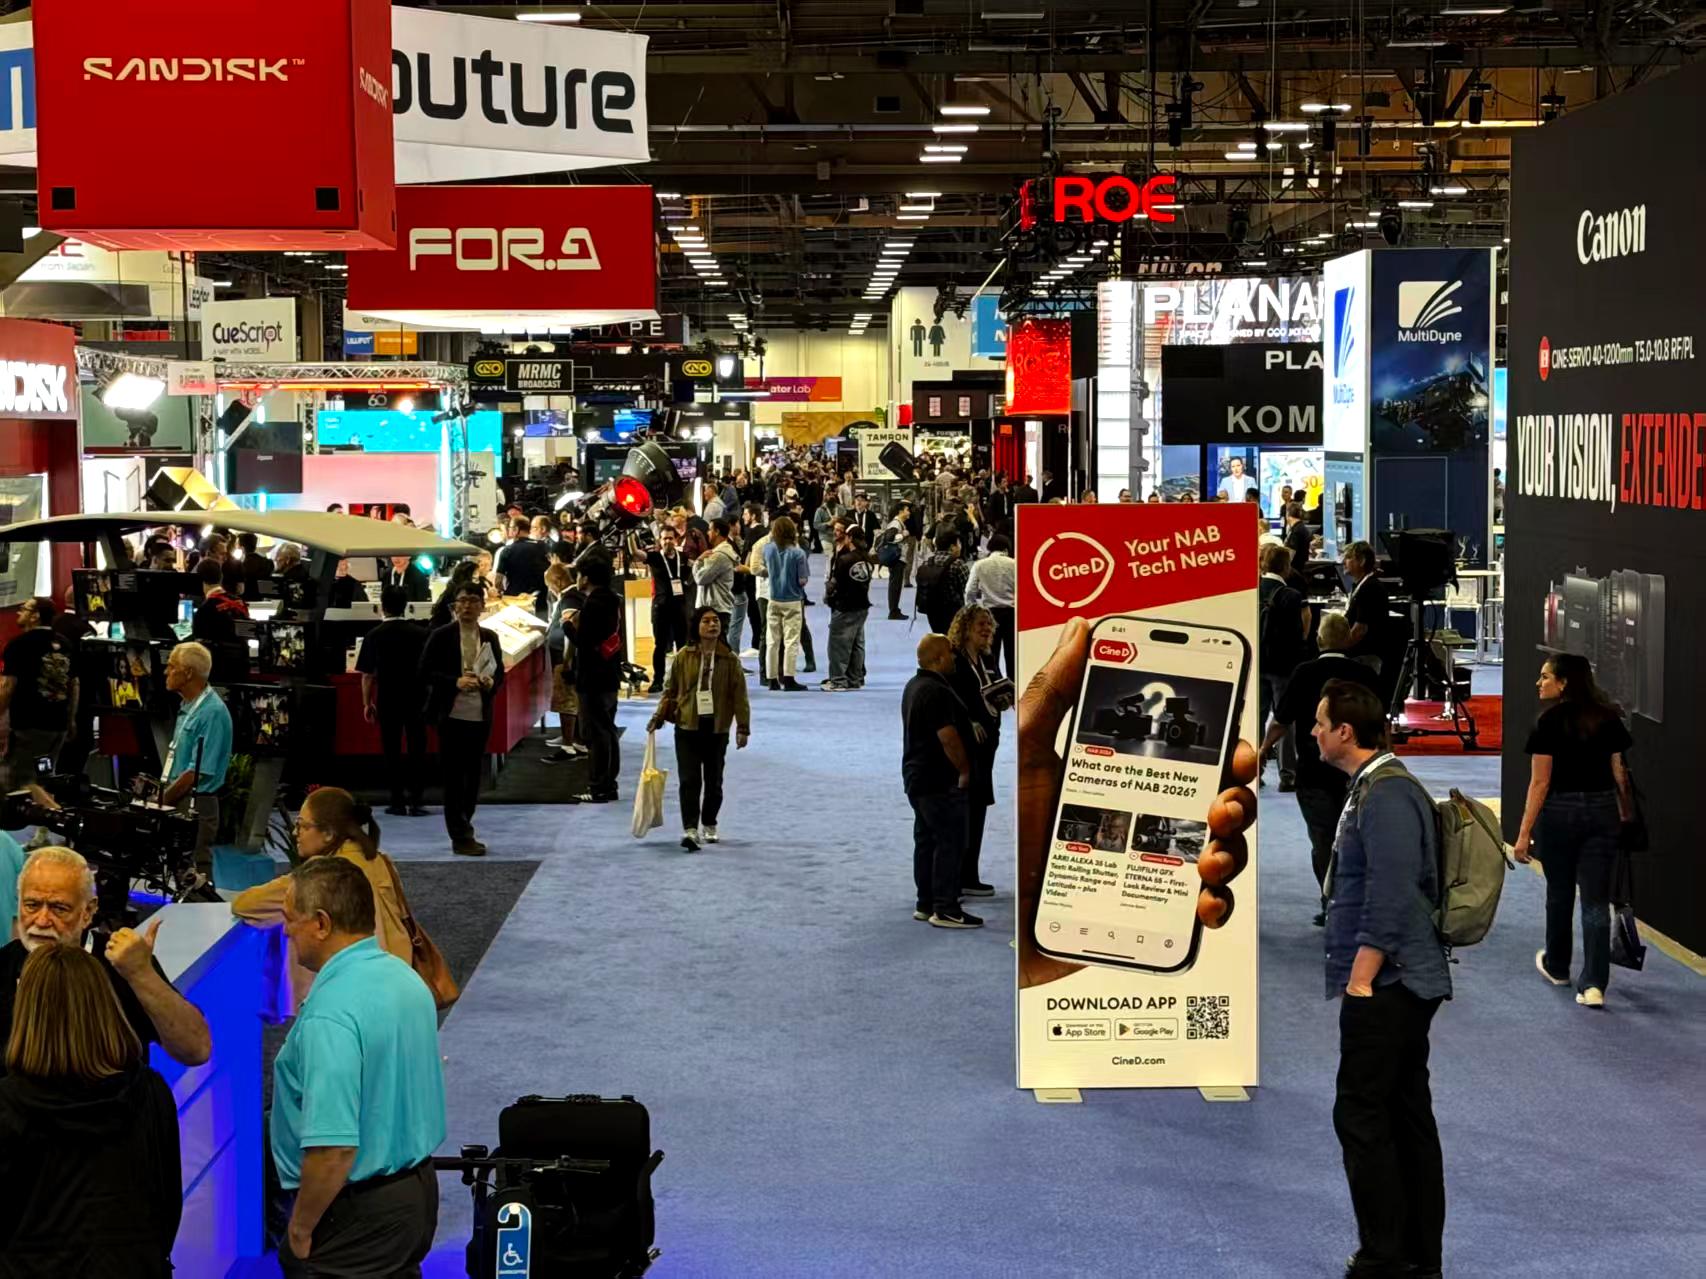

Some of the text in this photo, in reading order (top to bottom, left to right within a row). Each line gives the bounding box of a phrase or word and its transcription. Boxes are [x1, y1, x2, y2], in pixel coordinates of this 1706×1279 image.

[1054, 176, 1175, 222] ROE
[1577, 204, 1646, 265] Canon
[212, 320, 283, 352] CueScript
[1398, 330, 1462, 344] MultiDyne
[1552, 346, 1592, 369] CINE-SERVO
[1593, 342, 1634, 366] 40-1200mm
[1635, 337, 1670, 362] T5.0-10.8
[1671, 335, 1695, 360] RF/PL
[1265, 350, 1323, 370] PLA
[518, 363, 562, 379] MRMC
[517, 380, 562, 389] BROADCAST
[793, 385, 811, 393] Lab
[1227, 405, 1316, 433] KOM
[867, 433, 909, 441] TAMRON
[1517, 414, 1554, 497] YOUR
[1558, 413, 1616, 514] VISION,
[1124, 525, 1221, 557] Your NAB
[1049, 557, 1105, 581] CineD
[1128, 548, 1237, 579] Tech News
[1099, 645, 1130, 657] CineD
[1071, 758, 1199, 783] What are the Best New
[1068, 772, 1197, 798] Cameras of NAB 2026?
[1068, 865, 1091, 875] Rolling
[1070, 857, 1094, 865] ALEXA
[1104, 861, 1117, 869] Lab
[1127, 864, 1175, 876] FUJIFILM GFX
[1049, 871, 1117, 887] Dynamic Range and
[1125, 873, 1153, 882] ETERNA
[1045, 889, 1068, 897] Video!
[1047, 880, 1076, 890] Latitude
[1082, 885, 1097, 893] plus
[1123, 882, 1140, 890] Look
[1141, 884, 1166, 893] Review
[1121, 890, 1169, 904] Documentary
[1047, 996, 1177, 1010] DOWNLOAD APP
[1065, 1028, 1106, 1038] App Store
[1133, 1027, 1174, 1037] Google Play
[1112, 1056, 1166, 1065] CineD.com
